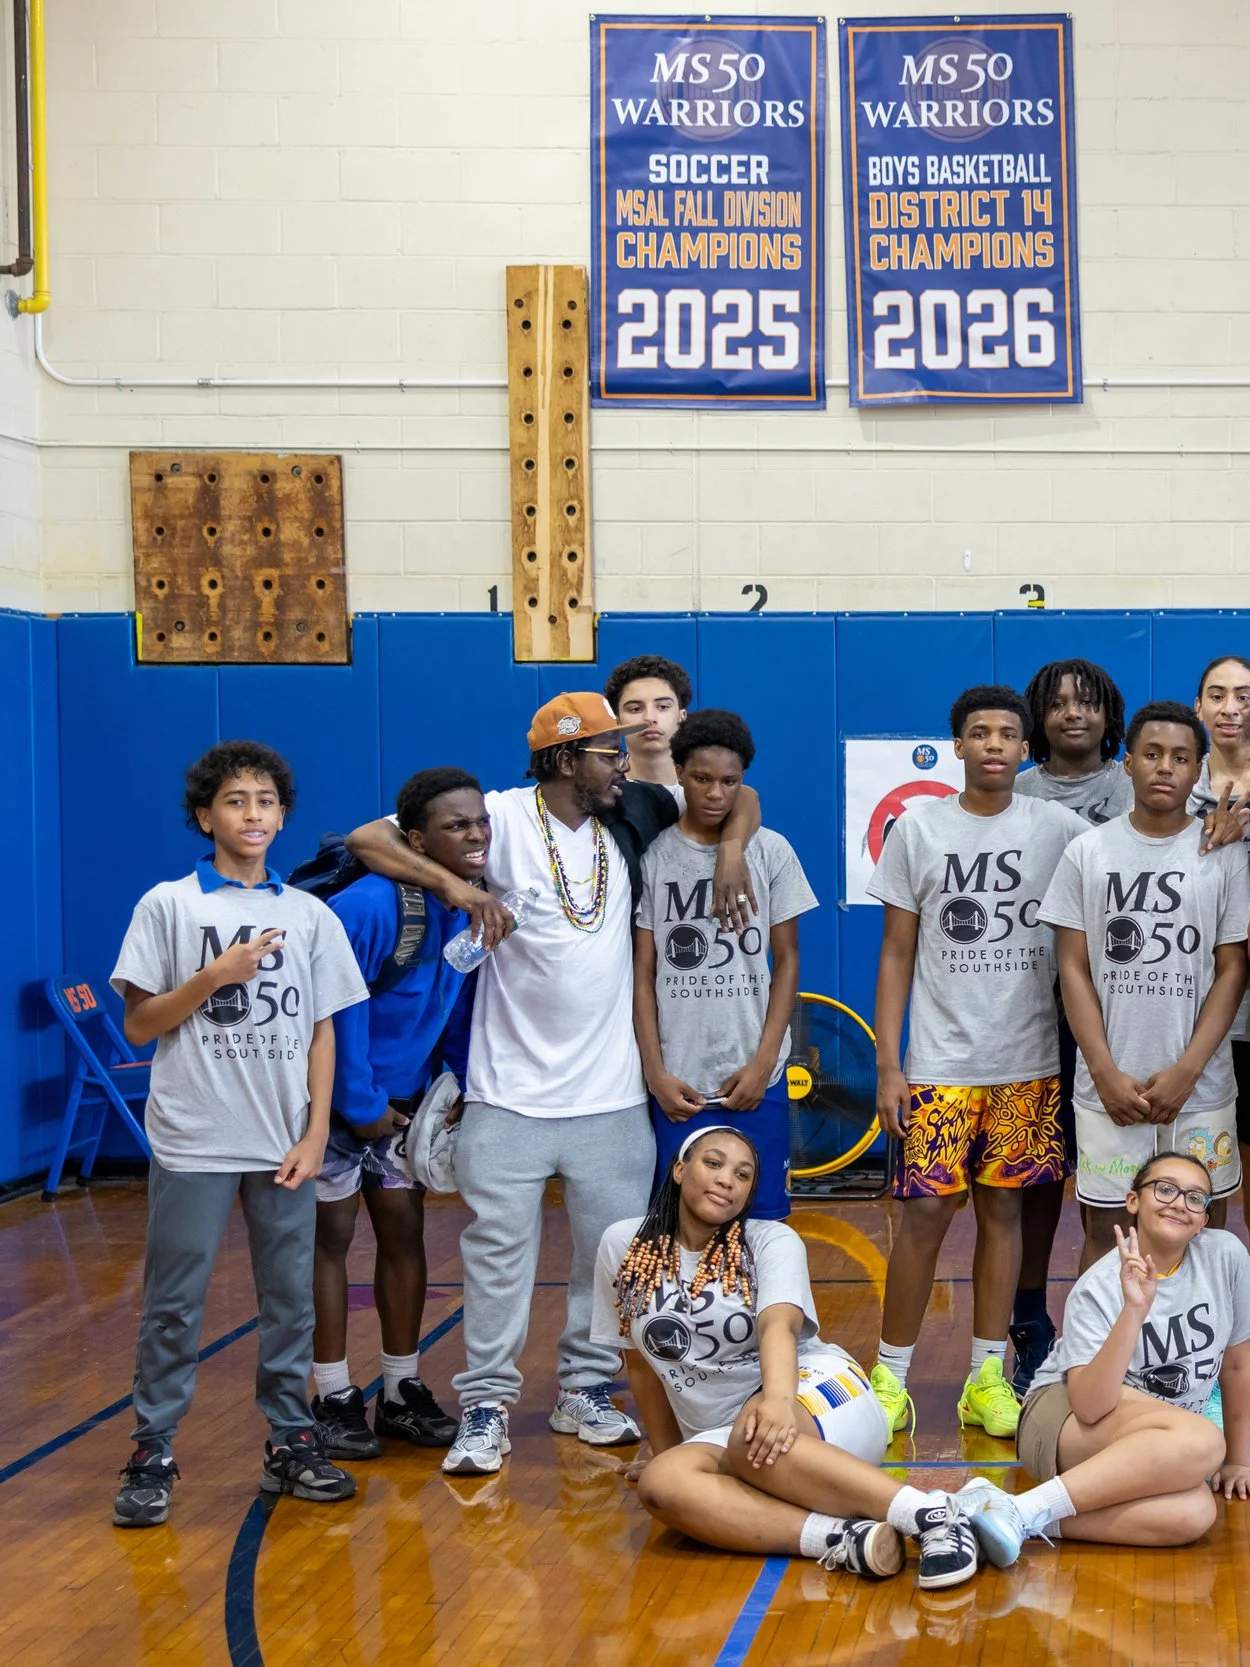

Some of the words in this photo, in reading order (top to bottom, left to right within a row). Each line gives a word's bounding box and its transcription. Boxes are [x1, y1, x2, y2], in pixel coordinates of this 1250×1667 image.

[650, 53, 711, 84] MS
[712, 53, 766, 93] 50
[899, 54, 958, 86] MS
[961, 53, 1013, 94] 50
[611, 98, 805, 128] WARRIORS
[861, 98, 1055, 128] WARRIORS
[648, 154, 769, 184] SOCCER
[868, 156, 919, 186] BOYS
[926, 153, 1052, 184] BASKETBALL
[616, 190, 669, 227] MSAL
[674, 189, 718, 226] FALL
[723, 191, 802, 227] DIVISION
[869, 189, 1010, 229] DISTRICT
[1021, 189, 1052, 226] 14
[616, 233, 802, 270] CHAMPIONS
[869, 232, 1055, 270] CHAMPIONS
[617, 288, 800, 370] 2025
[873, 288, 1056, 370] 2026
[741, 584, 768, 612] 2
[917, 747, 930, 755] MS
[940, 850, 1022, 894] MS
[664, 878, 732, 922] M
[1105, 871, 1185, 914] MS
[988, 899, 1042, 943] 50
[709, 926, 761, 969] 50
[942, 950, 987, 960] PRIDE
[994, 949, 1012, 959] OF
[1019, 946, 1045, 957] THE
[1142, 923, 1200, 964] 50
[666, 975, 708, 986] PRIDE
[714, 974, 734, 985] OF
[949, 961, 1038, 973] SOUTHSIDE
[1103, 970, 1140, 982] PRIDE
[1148, 971, 1169, 981] OF
[1175, 973, 1194, 984] TH
[76, 984, 97, 1010] 50
[254, 981, 300, 1026] 50
[670, 987, 760, 998] SOUTHSIDE
[1110, 985, 1193, 998] SOUTHSIDE
[202, 1034, 254, 1046] PRIDE
[695, 1312, 754, 1361] 50
[1140, 1303, 1215, 1370] MS
